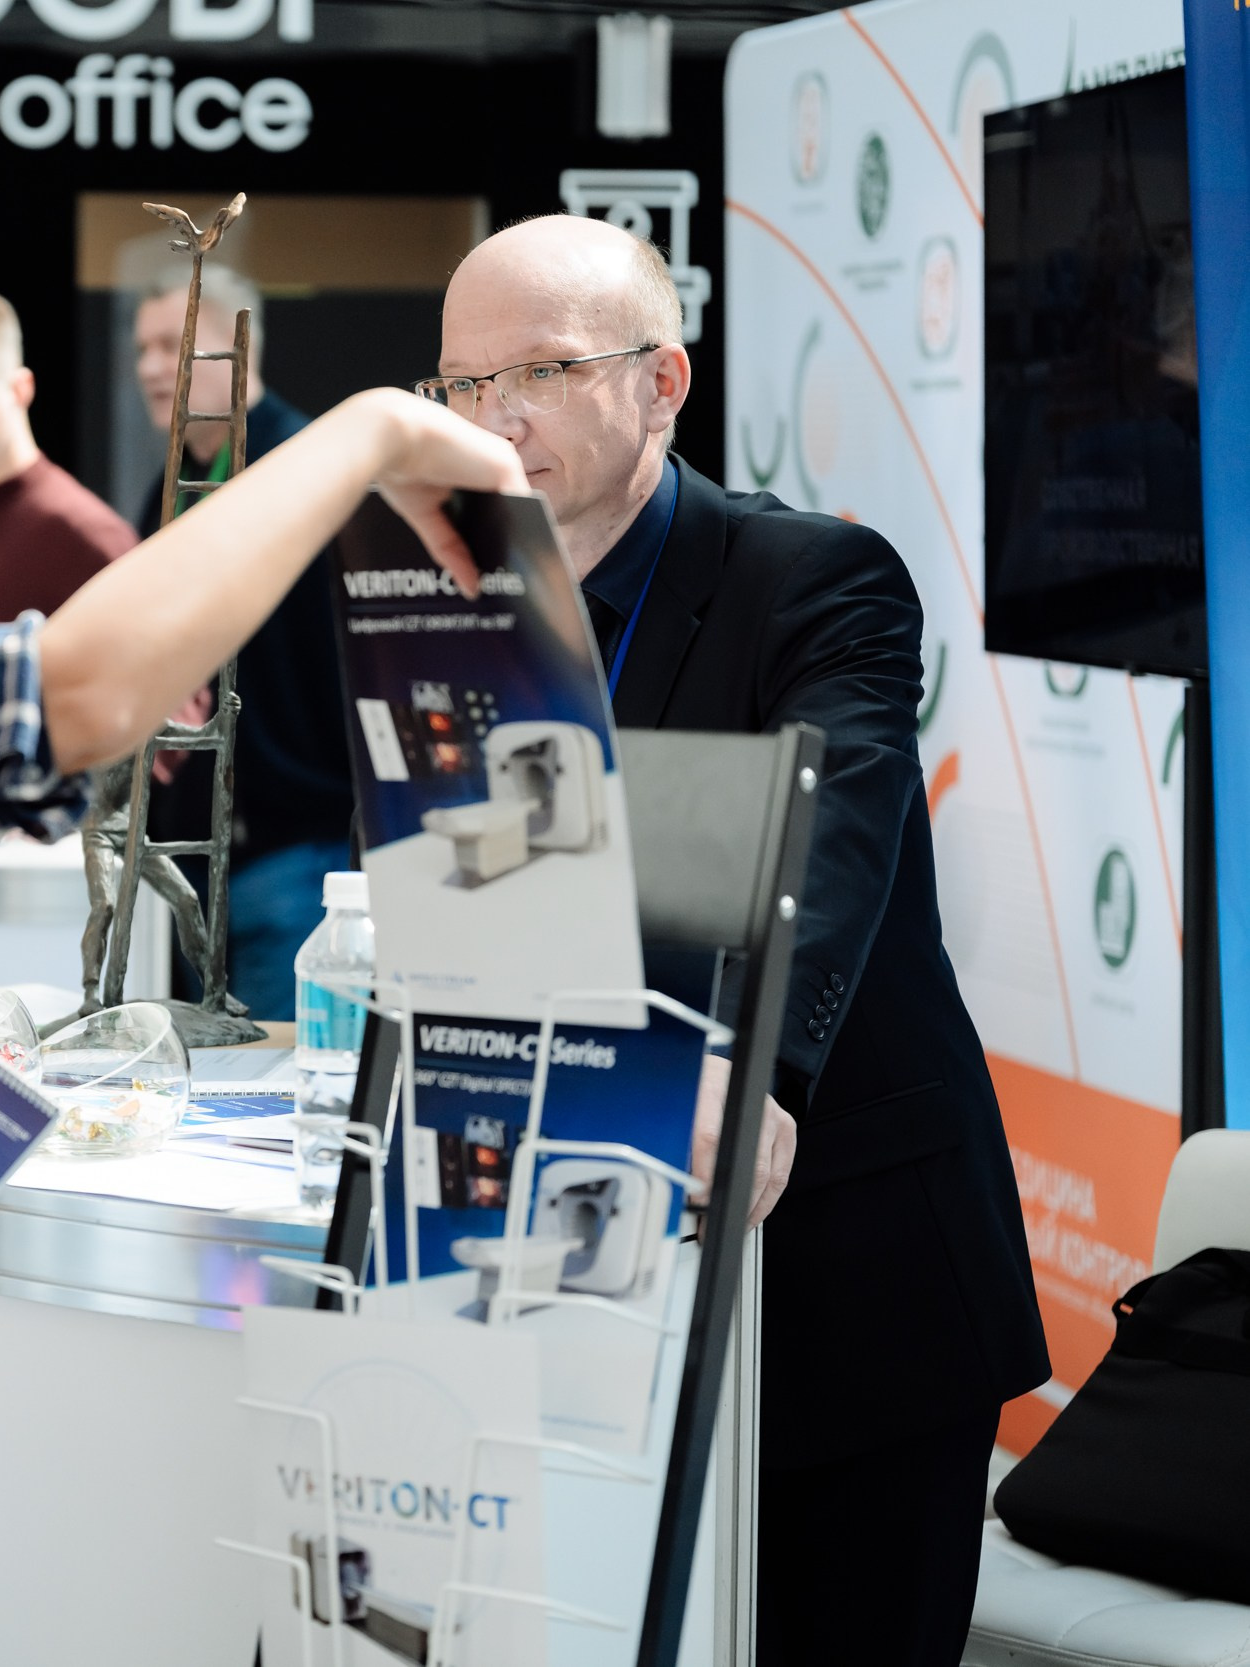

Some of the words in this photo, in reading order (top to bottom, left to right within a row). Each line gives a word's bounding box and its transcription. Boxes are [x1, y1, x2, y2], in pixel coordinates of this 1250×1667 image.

[342, 568, 459, 598] VERITON-C
[419, 1024, 539, 1062] VERITON-C
[551, 1037, 617, 1069] Series
